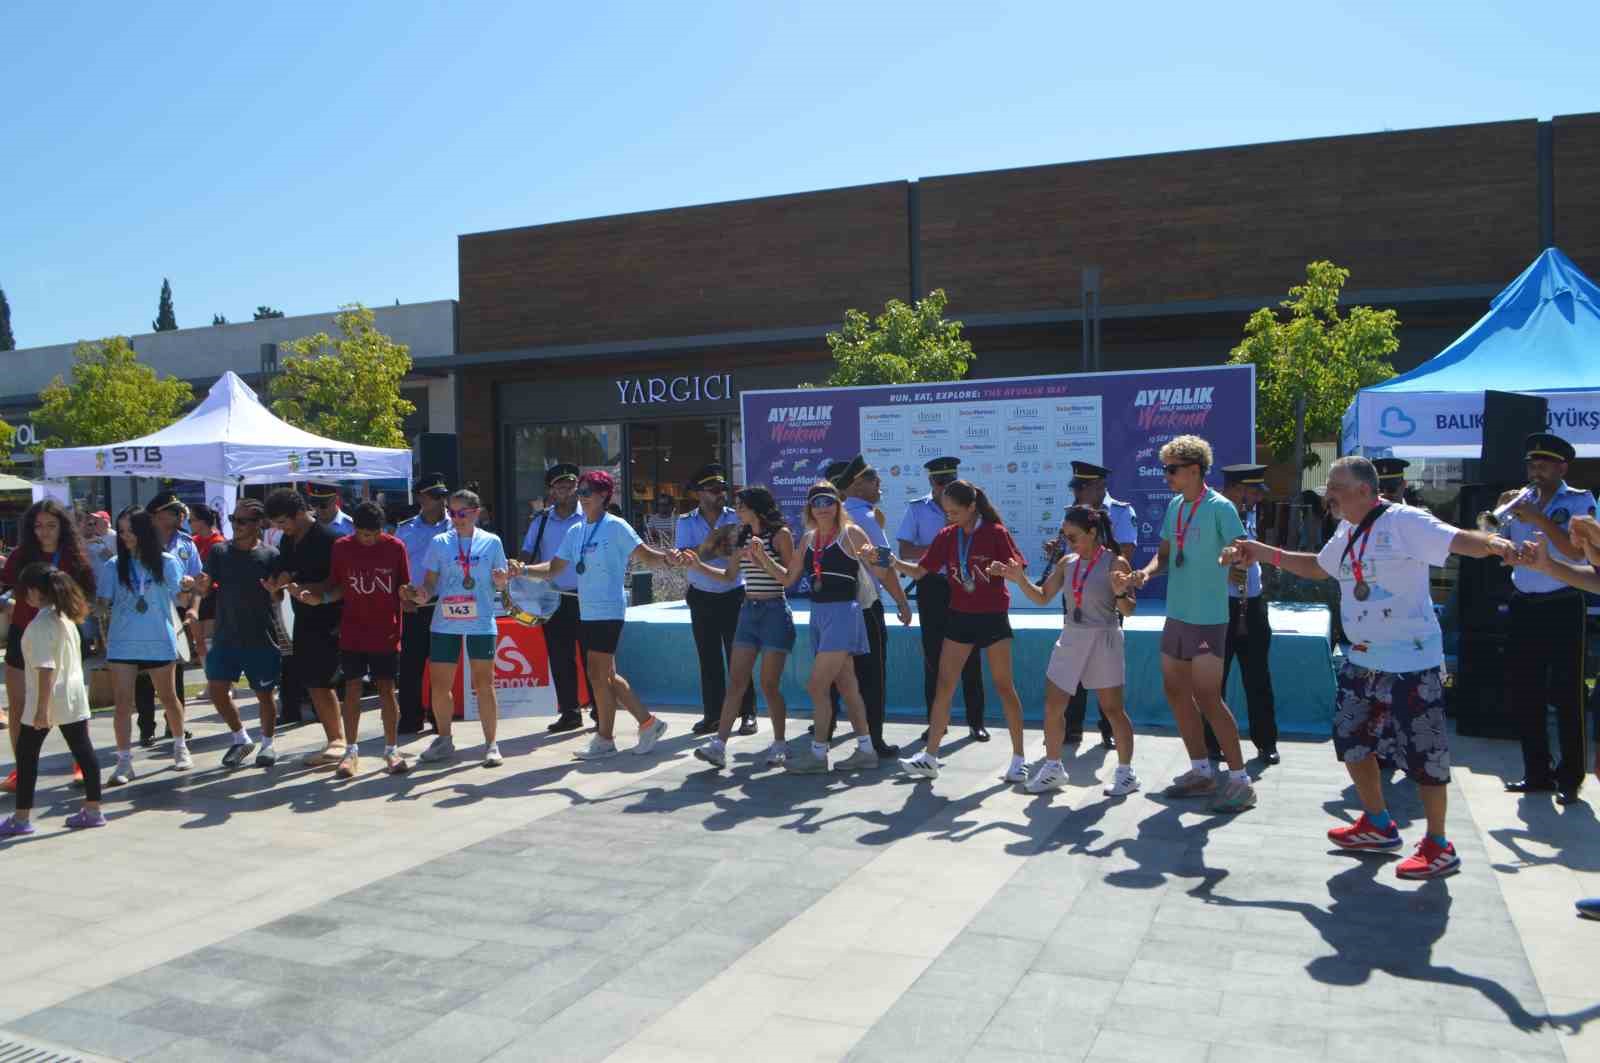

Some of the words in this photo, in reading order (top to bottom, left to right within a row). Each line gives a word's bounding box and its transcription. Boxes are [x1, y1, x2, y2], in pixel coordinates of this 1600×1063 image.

[616, 374, 732, 404] YARGICI
[890, 393, 911, 402] RUN,
[914, 392, 934, 401] EAT,
[935, 389, 981, 400] EXPLORE:
[1135, 386, 1215, 406] AYVALIK
[768, 405, 833, 422] AYVALIK
[11, 423, 40, 445] OL
[112, 446, 162, 463] STB
[307, 450, 357, 467] STB
[1138, 465, 1165, 477] Setu
[349, 575, 392, 594] RUN
[449, 605, 470, 615] 143
